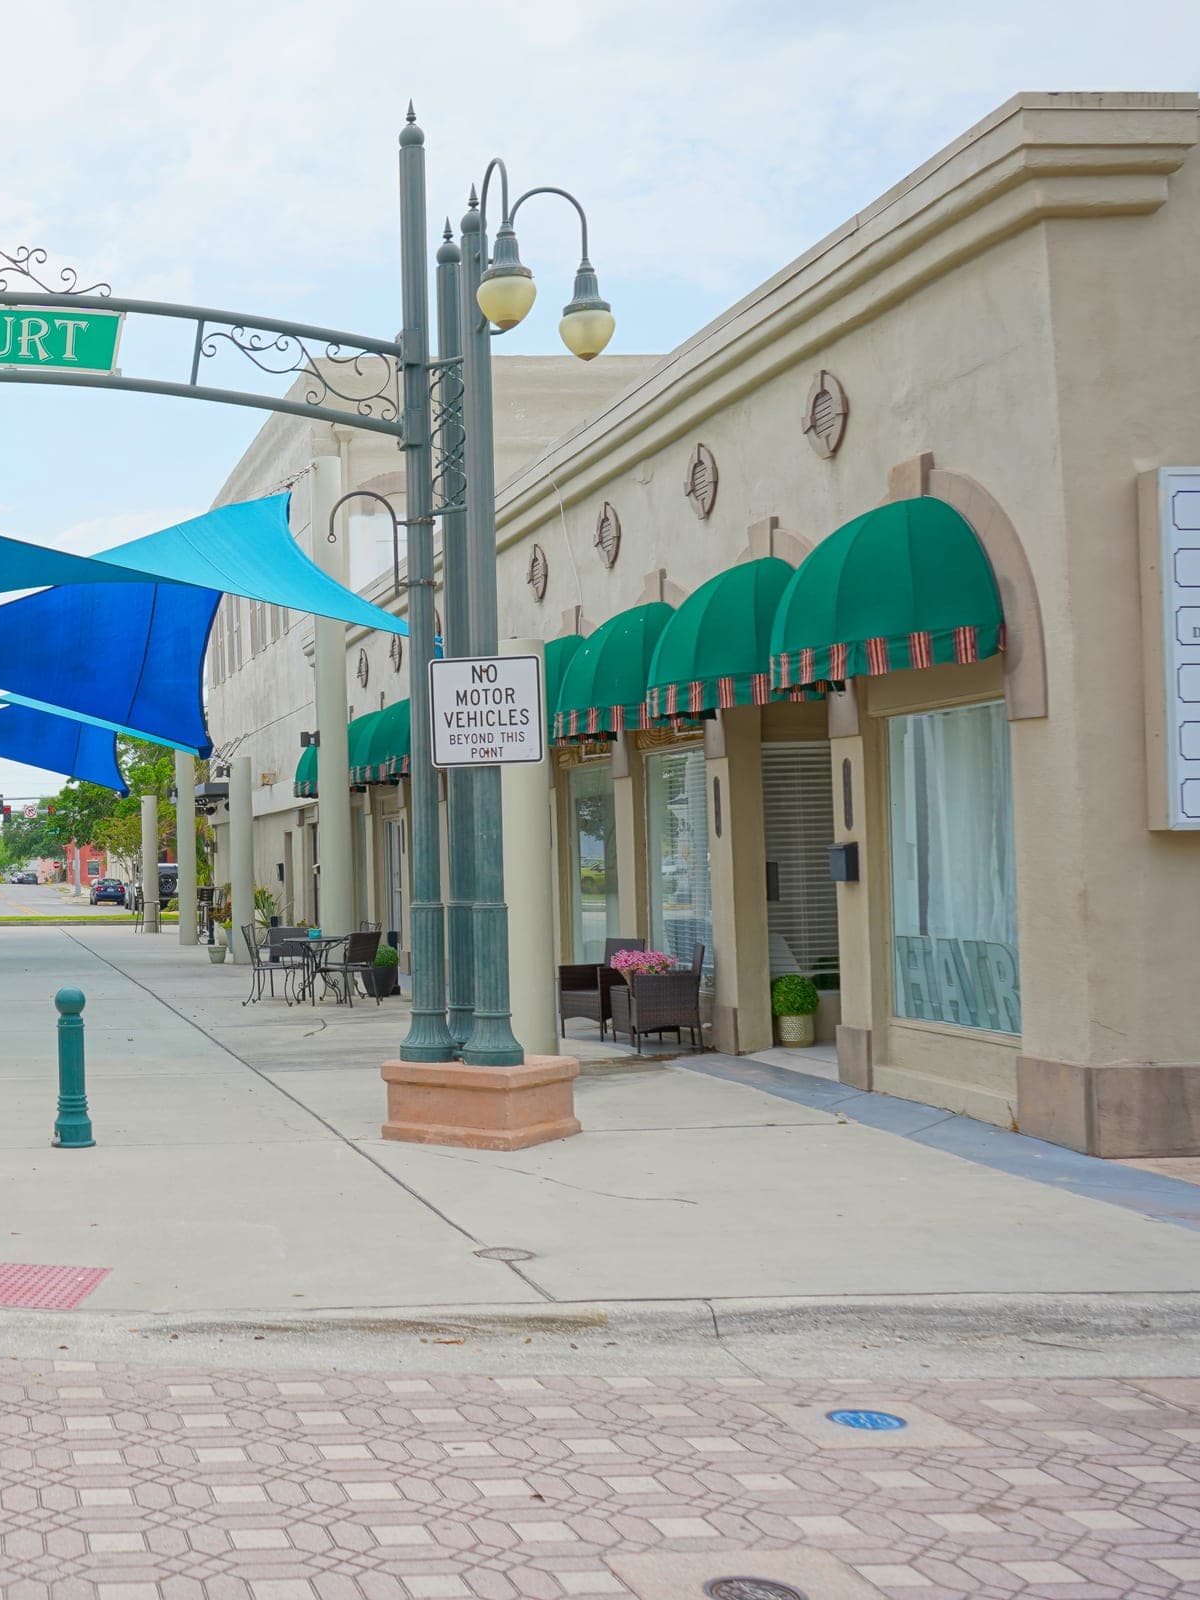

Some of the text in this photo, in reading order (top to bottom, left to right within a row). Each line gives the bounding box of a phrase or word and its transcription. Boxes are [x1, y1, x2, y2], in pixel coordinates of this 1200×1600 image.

[471, 664, 498, 684] NO
[455, 687, 515, 706] MOTOR
[443, 708, 530, 728] VEHICLES
[449, 731, 526, 745] BEYOND THIS
[471, 746, 505, 759] POINT
[896, 935, 1021, 1033] HAIR
